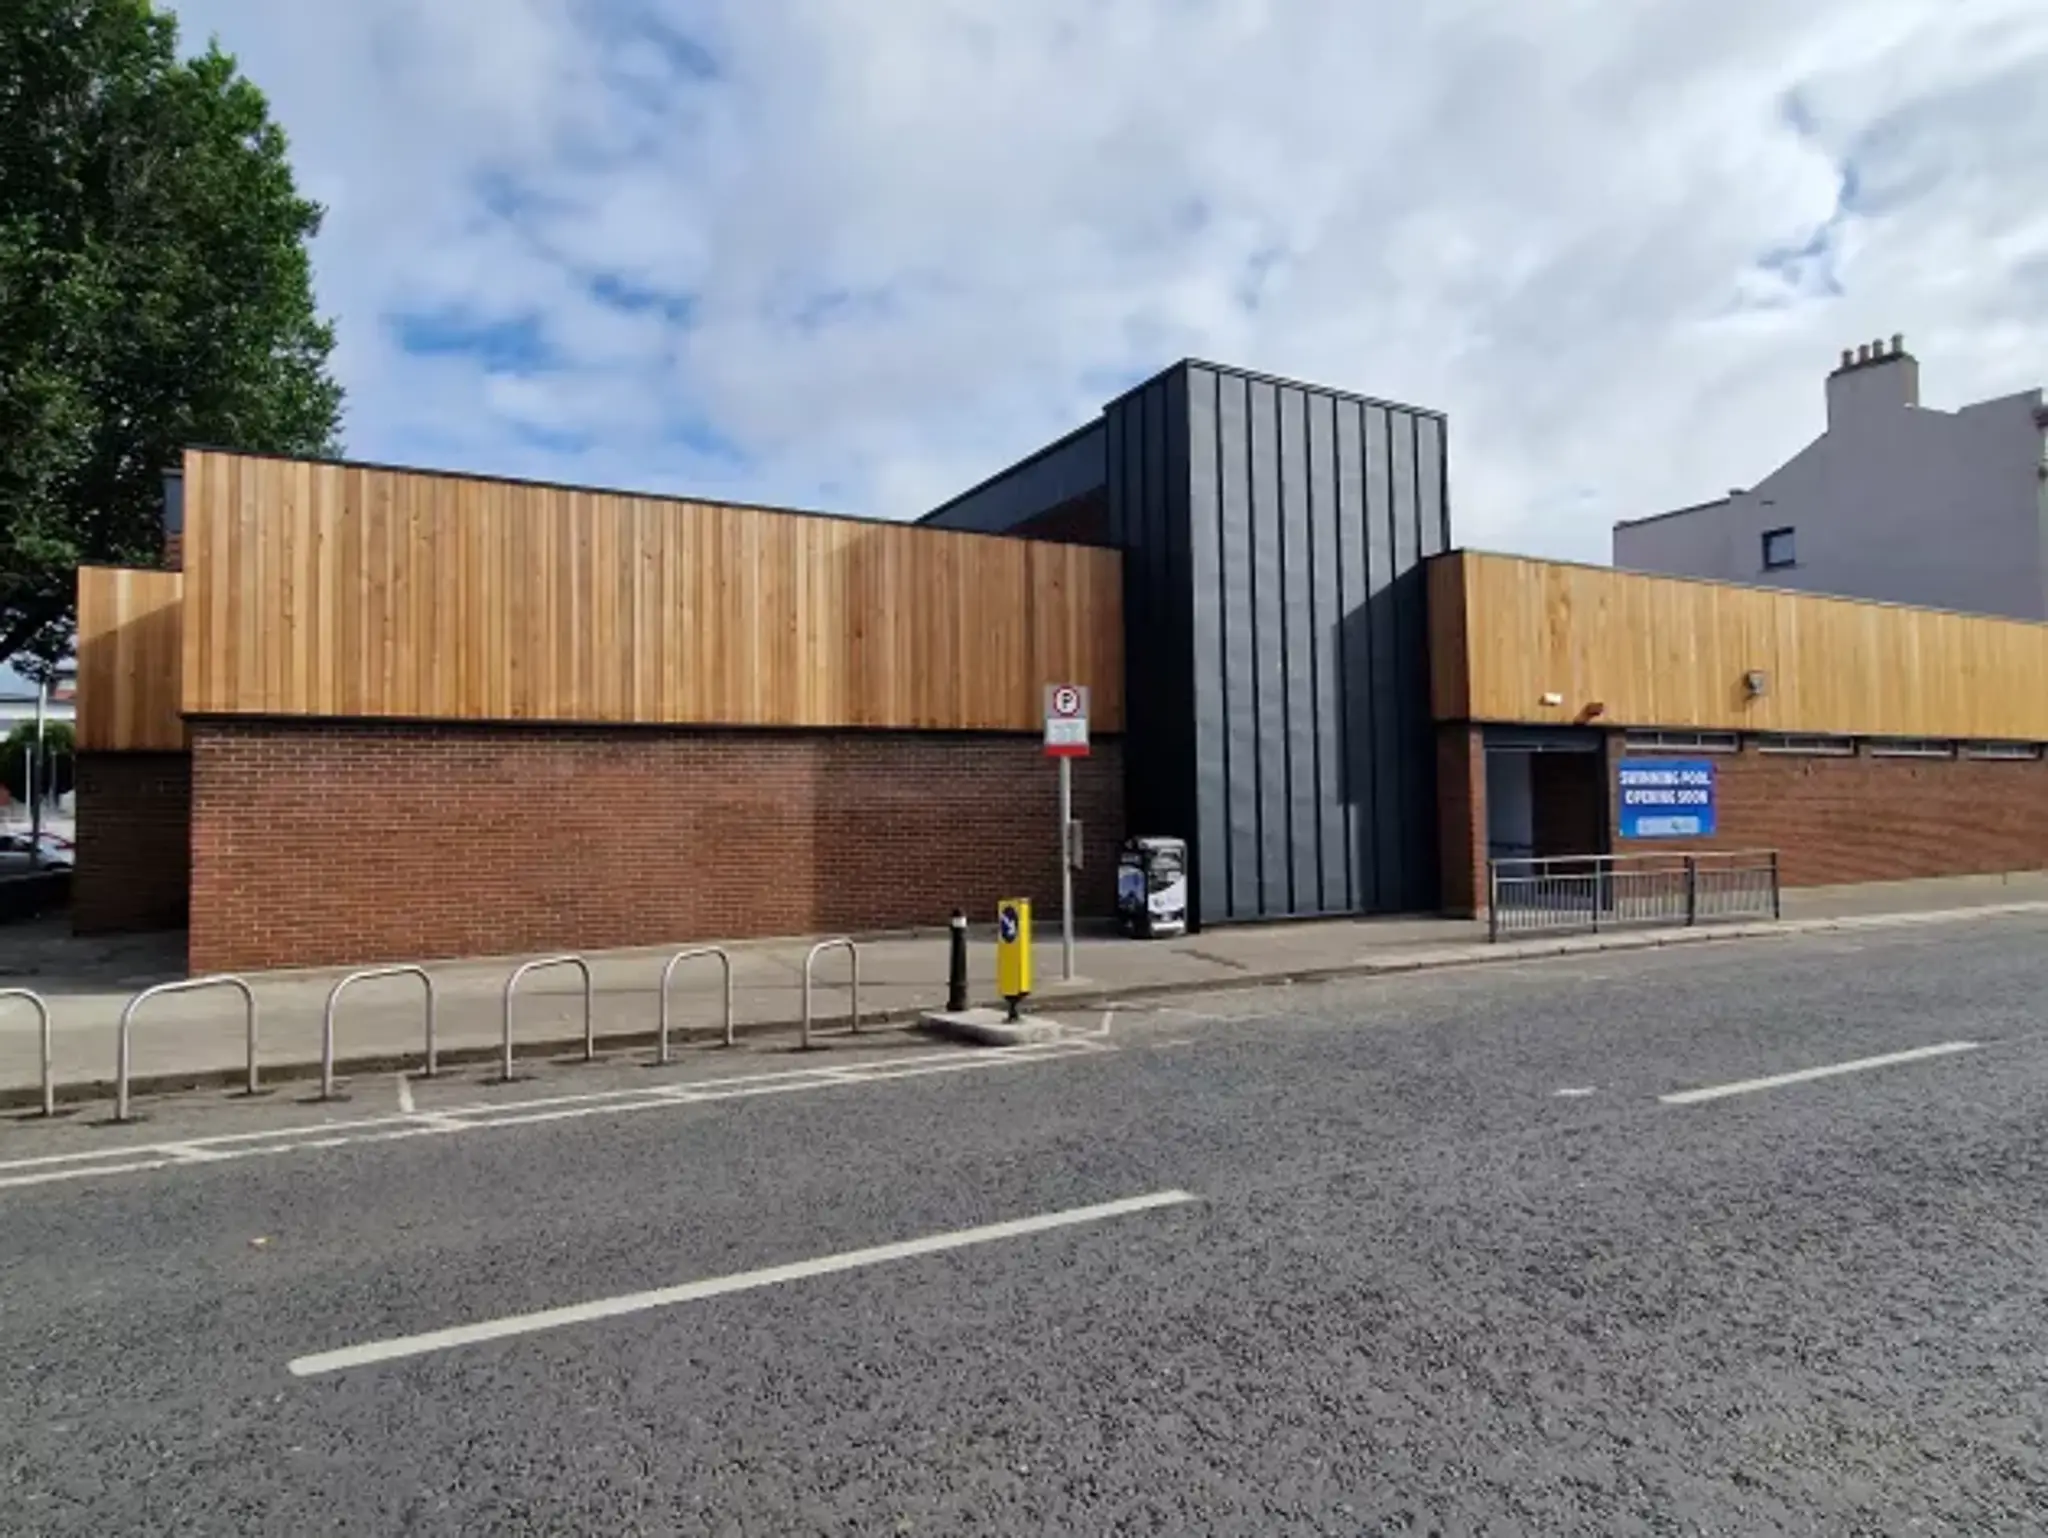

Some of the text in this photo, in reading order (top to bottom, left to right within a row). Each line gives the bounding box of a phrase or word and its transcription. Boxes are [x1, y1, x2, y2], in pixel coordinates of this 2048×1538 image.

[1681, 770, 1711, 785] POOL
[1625, 789, 1708, 804] OPENING SOON
